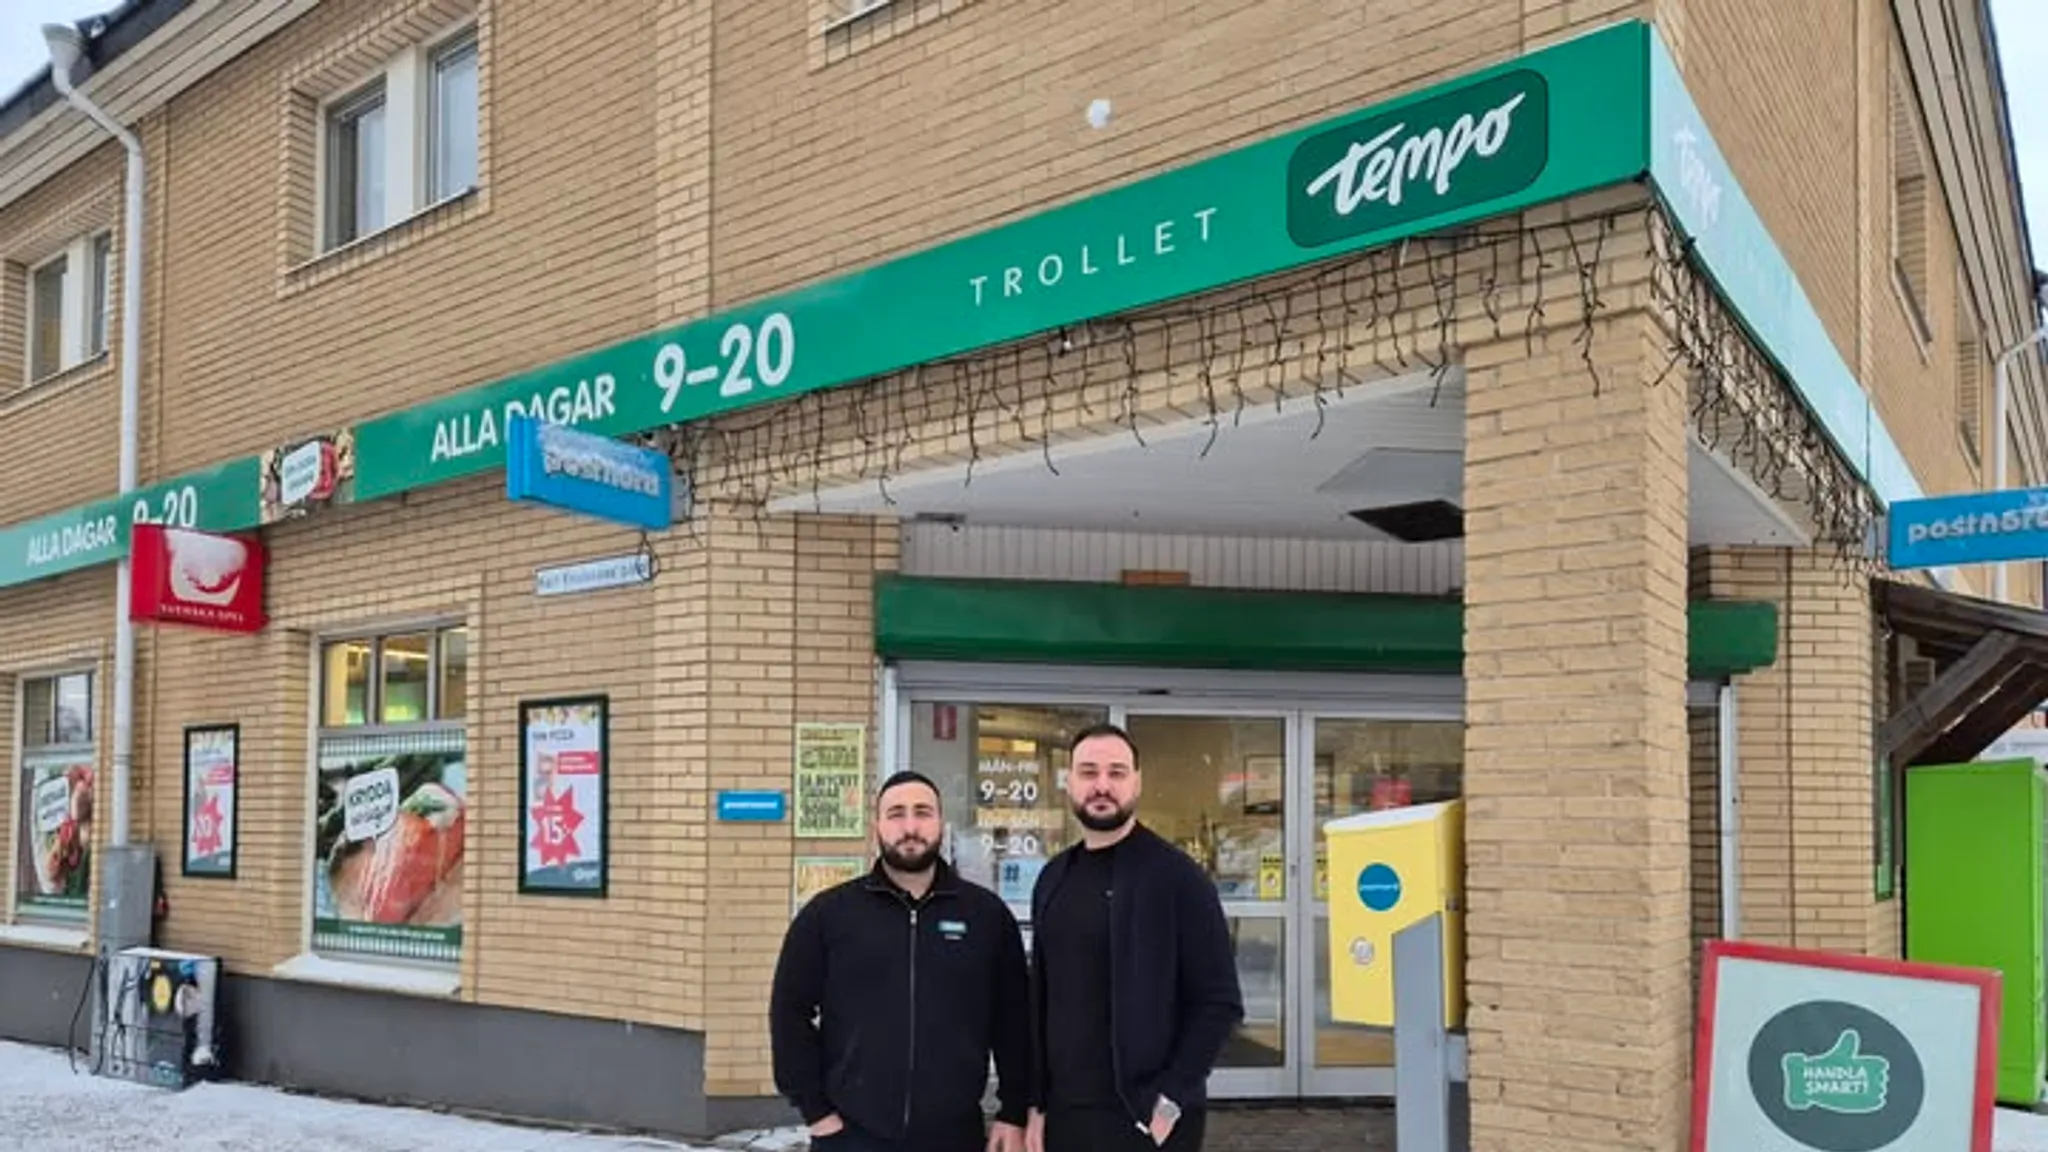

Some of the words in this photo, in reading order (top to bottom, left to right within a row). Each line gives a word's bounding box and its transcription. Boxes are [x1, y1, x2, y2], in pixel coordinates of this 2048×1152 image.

[1307, 92, 1526, 215] tempo
[970, 208, 1217, 306] TROLLET
[431, 408, 498, 463] ALLA
[26, 534, 61, 566] ALLA
[62, 515, 117, 556] DAGAR
[980, 779, 1038, 801] 9-20
[981, 834, 1037, 857] 9-20
